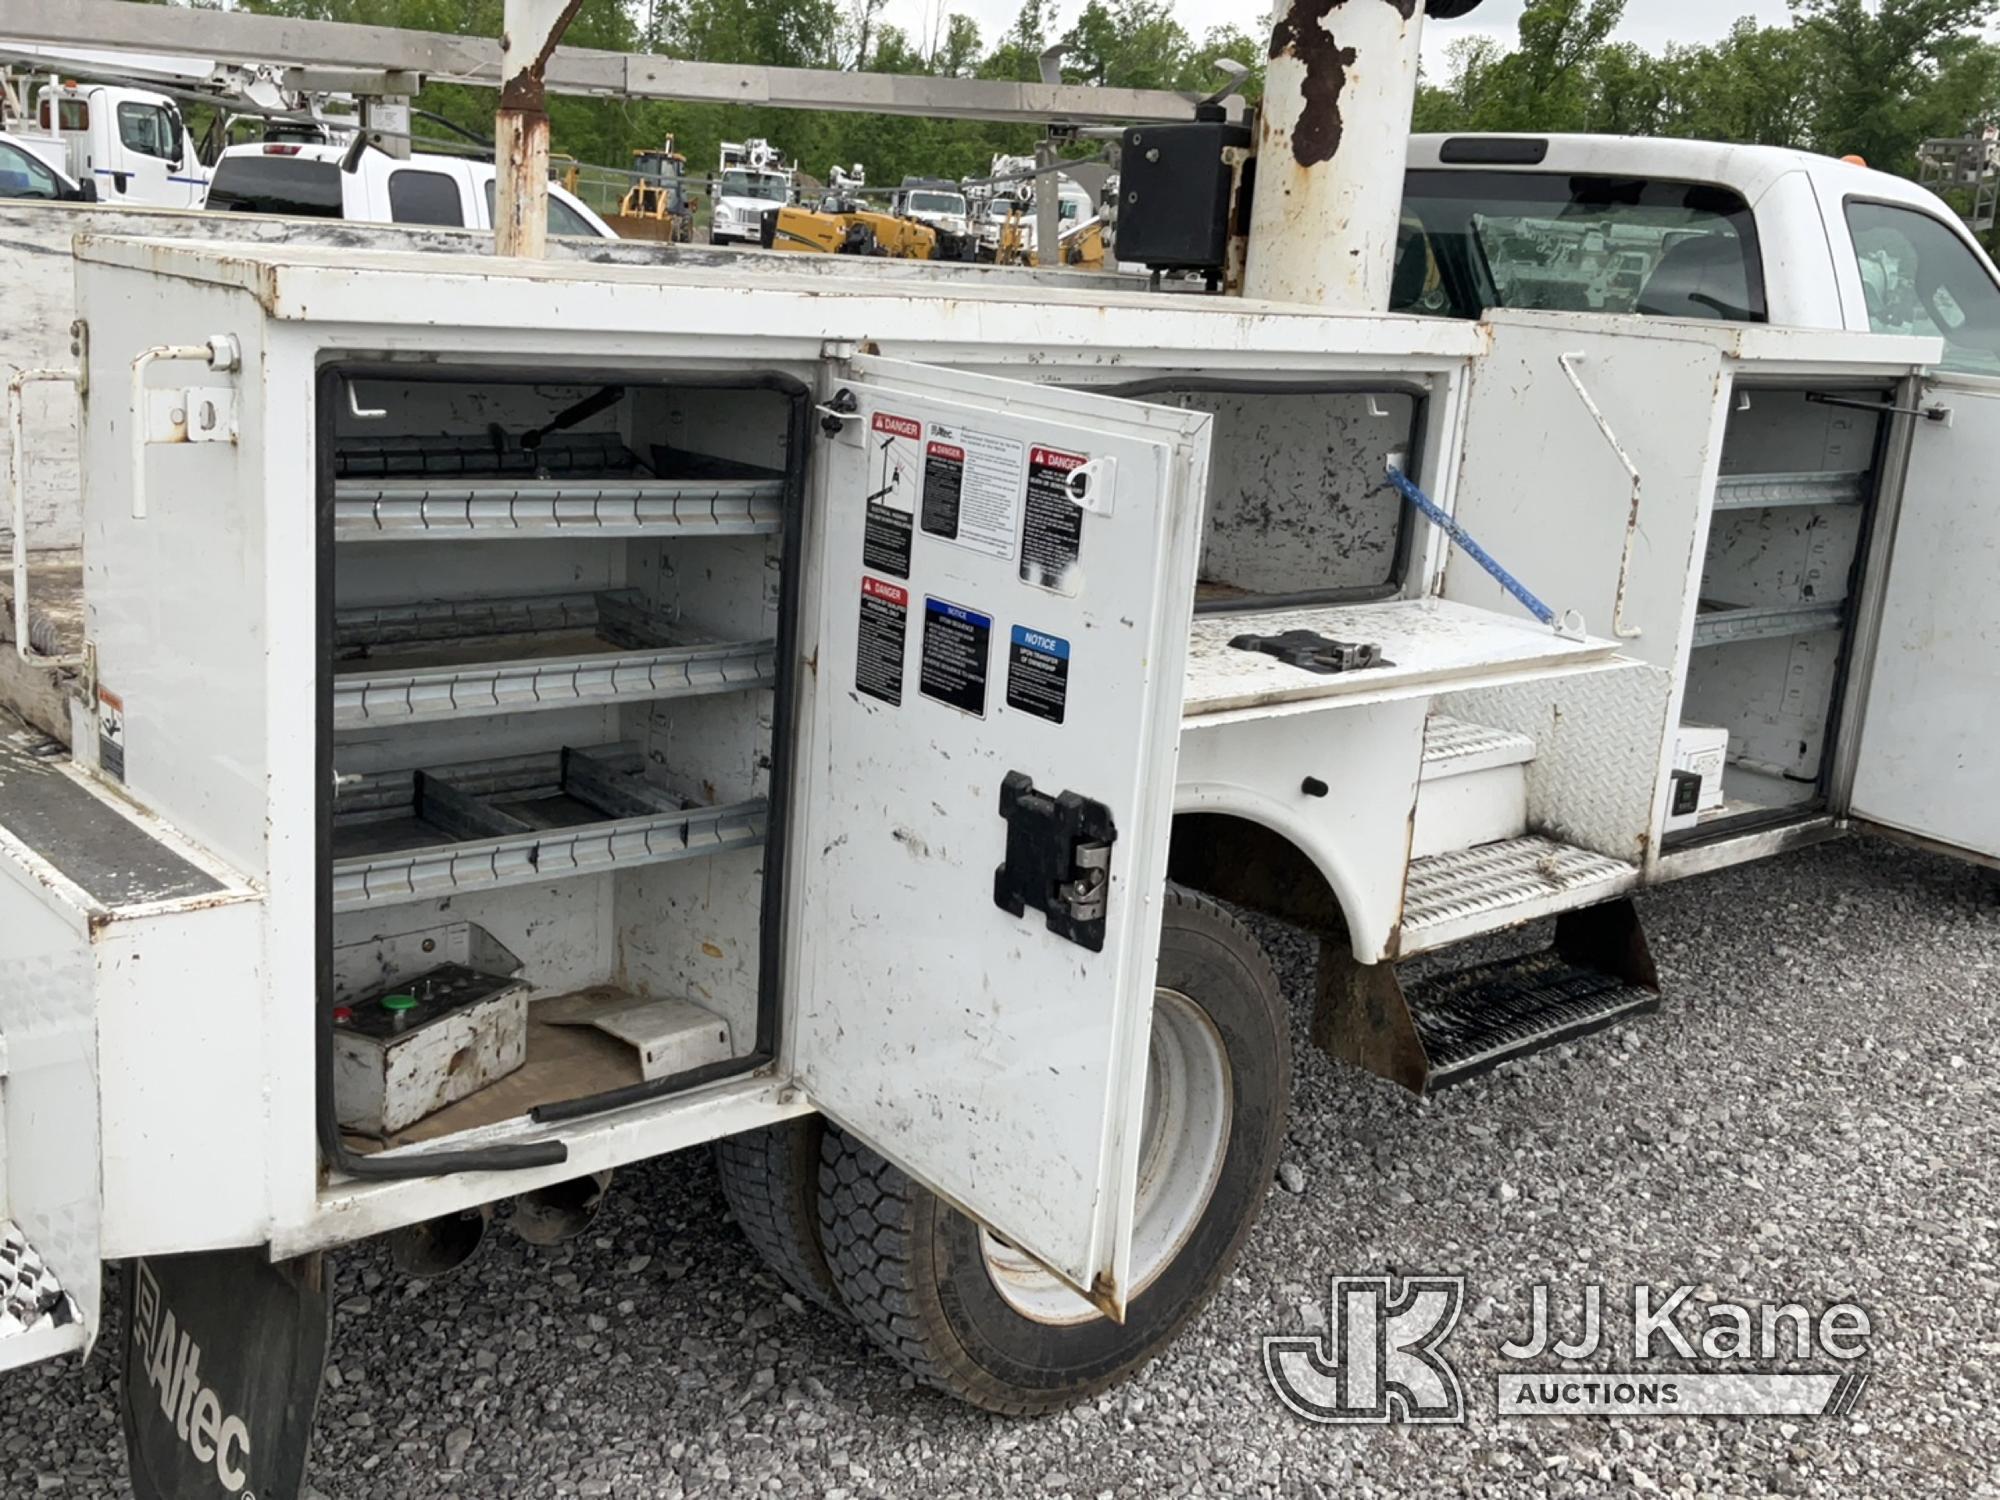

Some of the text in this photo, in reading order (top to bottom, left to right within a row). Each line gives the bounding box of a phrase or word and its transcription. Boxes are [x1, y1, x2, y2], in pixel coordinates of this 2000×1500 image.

[884, 418, 918, 437] DANGER
[936, 445, 960, 457] DANGER
[875, 582, 901, 600] DANGER
[947, 606, 967, 620] NOTICE
[1024, 632, 1057, 651] NOTICE
[150, 1308, 250, 1491] Altec
